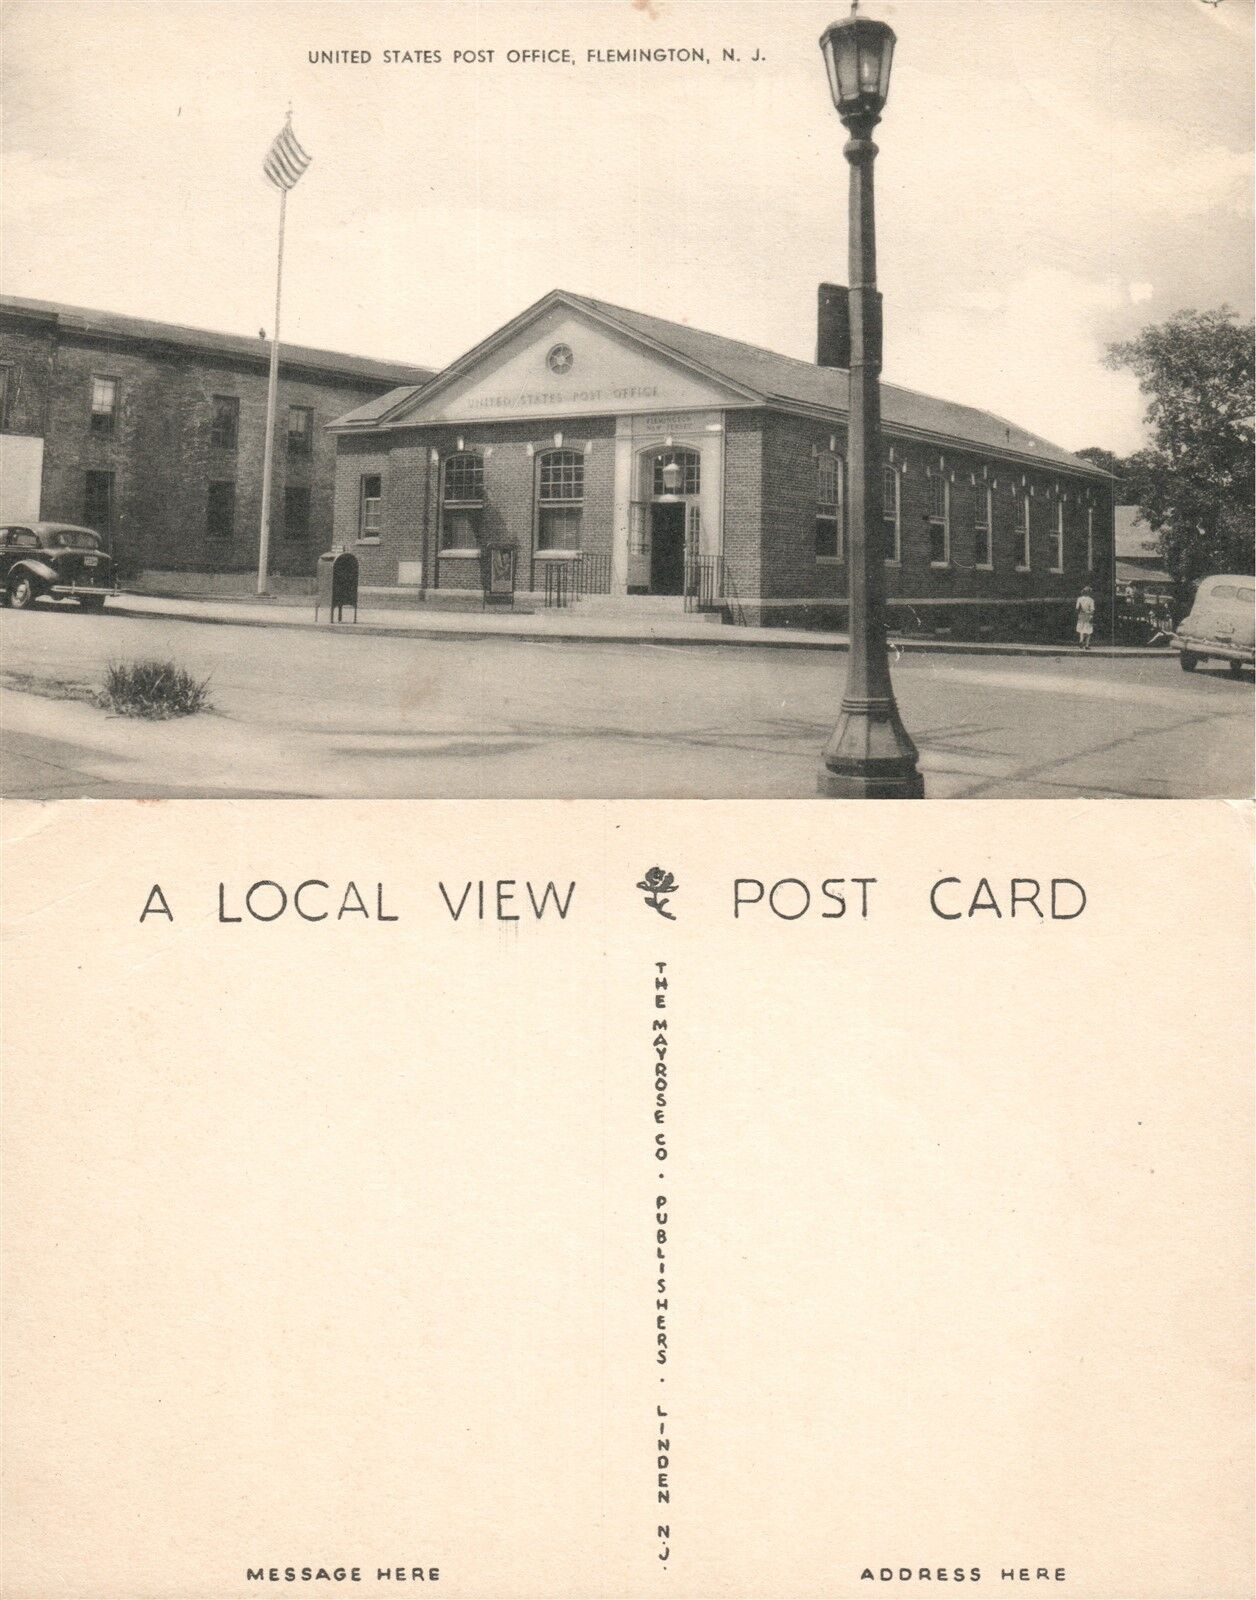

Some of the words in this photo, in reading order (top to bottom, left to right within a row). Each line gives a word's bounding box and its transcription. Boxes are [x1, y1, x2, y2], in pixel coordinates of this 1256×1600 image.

[573, 389, 602, 402] POST
[612, 386, 659, 399] OFFICE
[139, 883, 174, 923] A
[218, 879, 399, 923] LOCAL
[438, 879, 576, 921] VIEW
[734, 877, 877, 921] POST
[930, 876, 1087, 920] CARD
[655, 961, 669, 1009] THE
[652, 1018, 668, 1124] MAYROSE
[655, 1195, 668, 1365] PUBLISHERS
[656, 1405, 670, 1504] LINDEN
[246, 1567, 362, 1582] MESSAGE
[377, 1567, 440, 1582] HERE
[860, 1567, 981, 1582] ADDRESS
[1001, 1567, 1066, 1582] HERE
